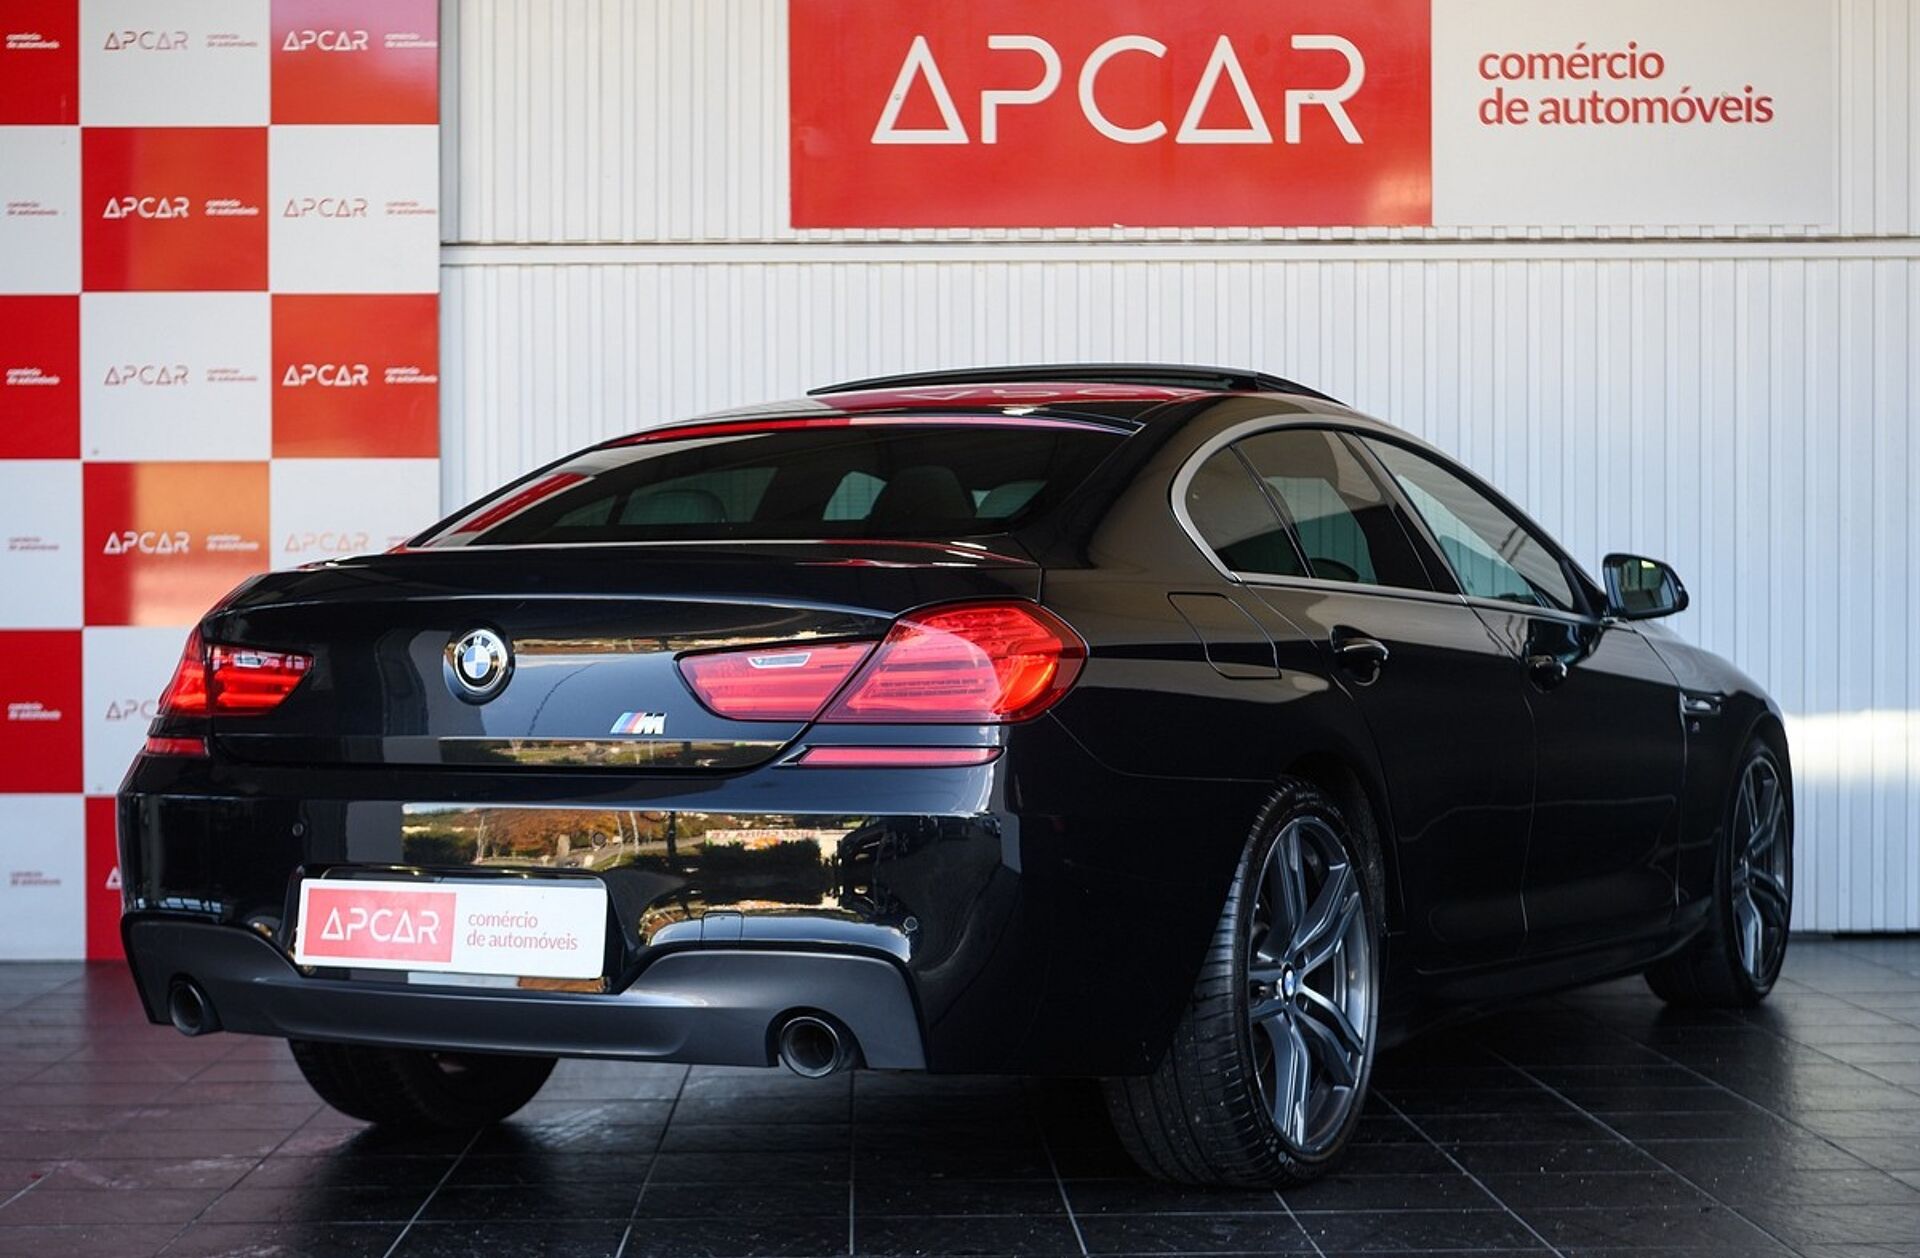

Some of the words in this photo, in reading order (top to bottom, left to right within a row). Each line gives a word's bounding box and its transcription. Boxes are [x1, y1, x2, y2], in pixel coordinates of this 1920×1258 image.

[104, 30, 188, 50] APCAR
[282, 30, 368, 50] APCAR
[1478, 41, 1665, 80] comércio
[871, 34, 1365, 144] APCAR
[1478, 86, 1530, 125] de
[1538, 84, 1774, 125] automóveis
[103, 196, 189, 218] APCAR
[283, 197, 368, 218] APCAR
[104, 365, 189, 386] APCAR
[282, 364, 368, 386] APCAR
[103, 531, 190, 553] APCAR
[105, 699, 157, 720] APC
[320, 907, 441, 944] APCAR
[468, 911, 538, 928] comércio
[466, 929, 487, 947] de
[489, 931, 578, 950] automóveis
